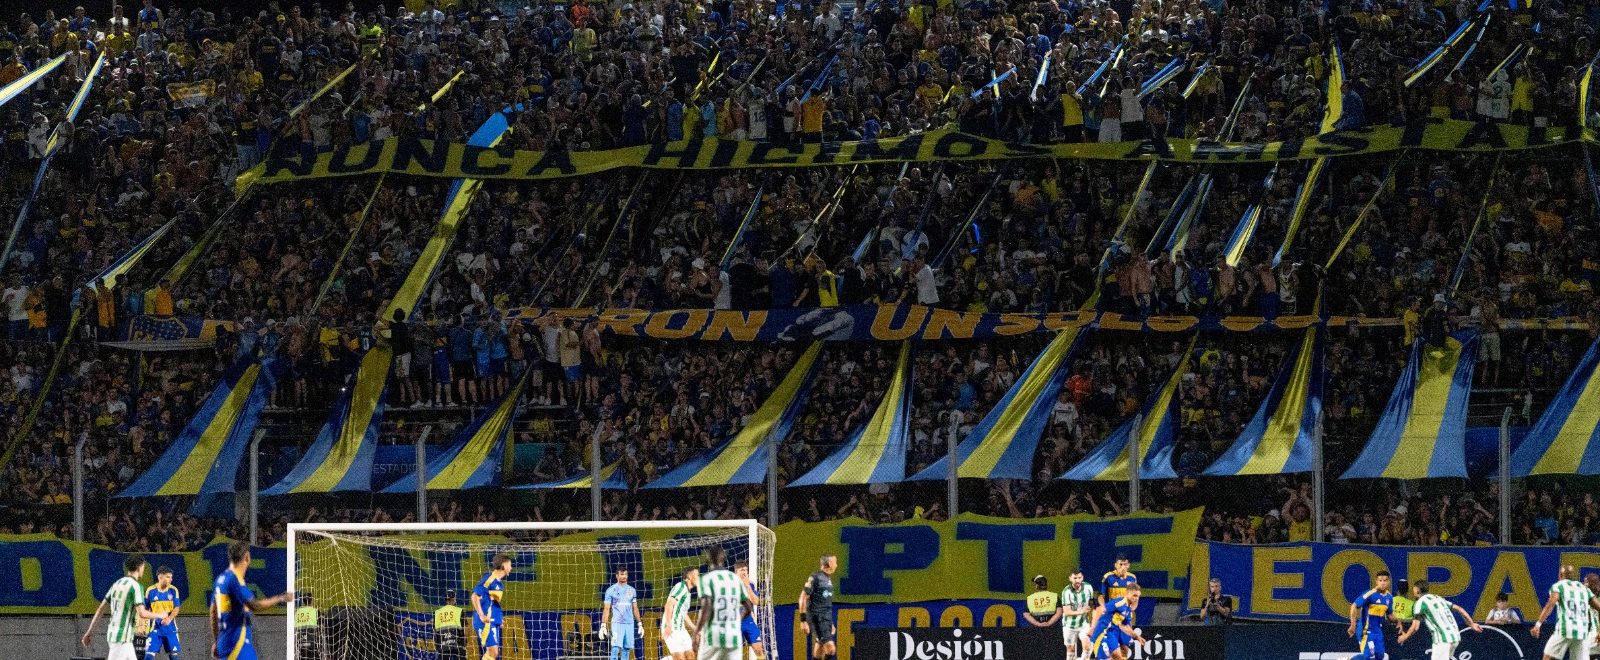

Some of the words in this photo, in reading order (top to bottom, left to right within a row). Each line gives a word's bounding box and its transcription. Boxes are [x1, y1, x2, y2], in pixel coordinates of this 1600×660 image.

[265, 135, 577, 177] NUNCA
[870, 302, 983, 341] UN
[717, 597, 738, 621] 23
